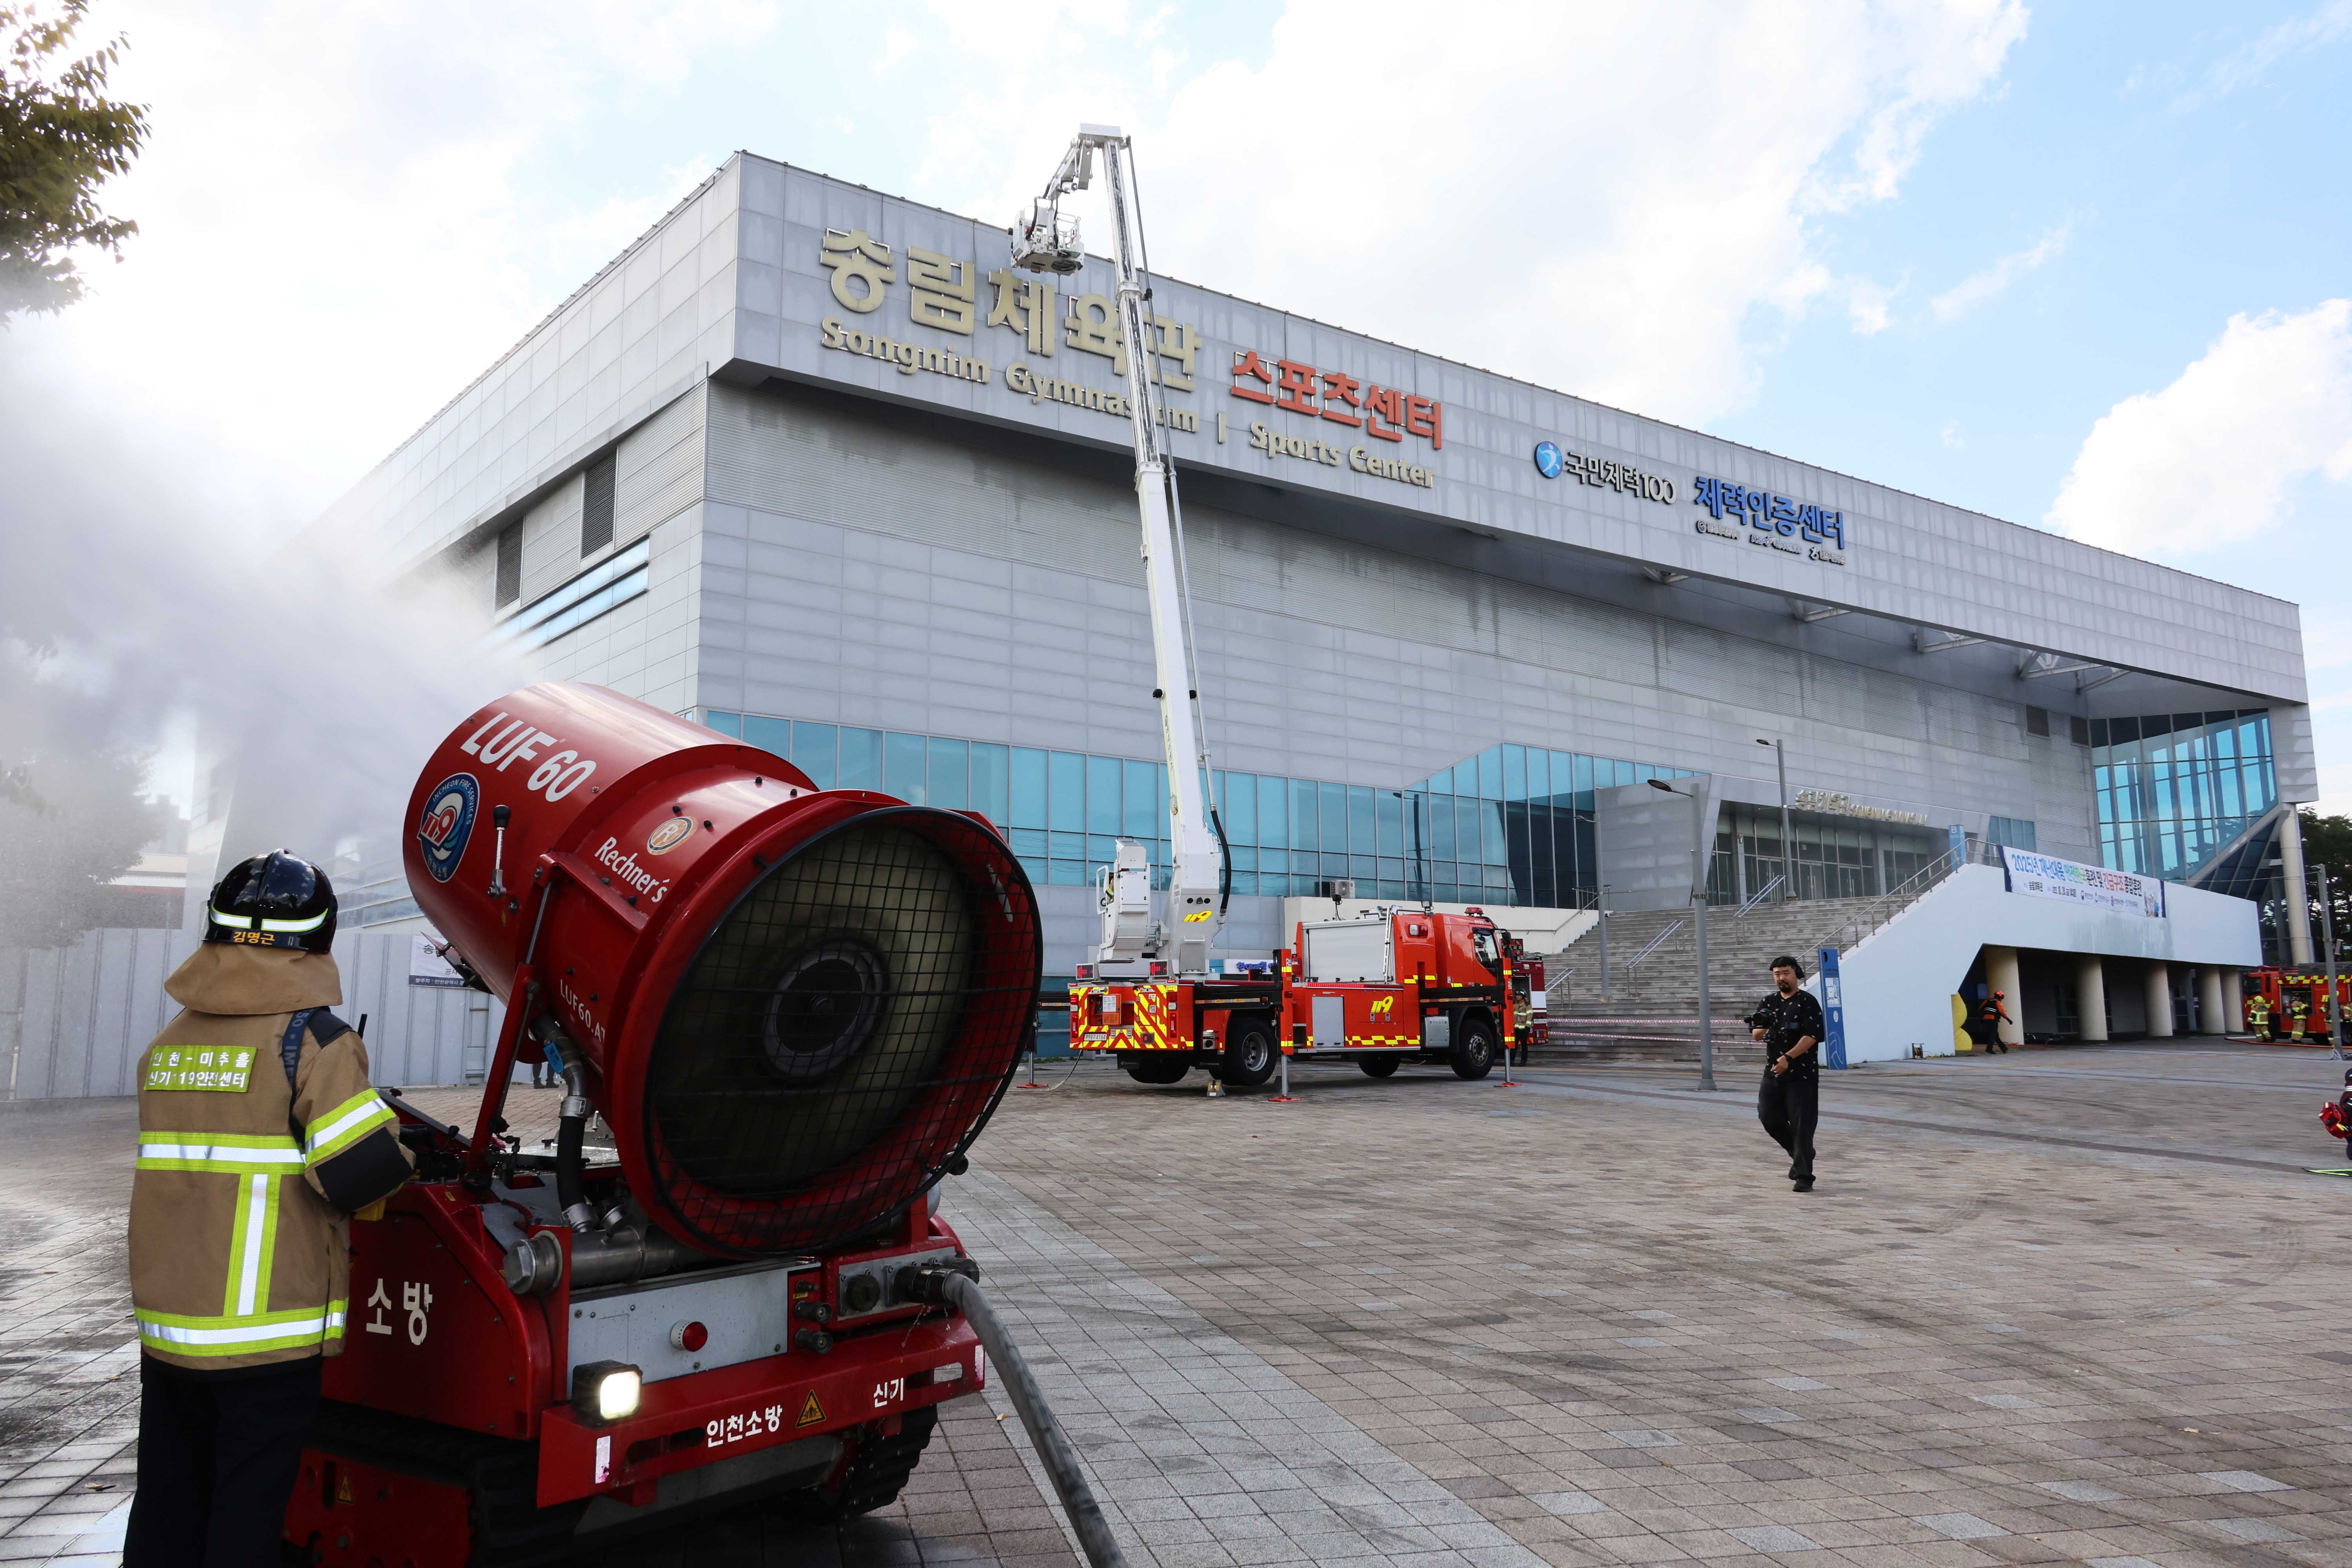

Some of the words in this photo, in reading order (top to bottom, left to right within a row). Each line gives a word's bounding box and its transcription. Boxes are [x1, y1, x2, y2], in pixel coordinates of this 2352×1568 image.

[820, 228, 1202, 392] 송림체육관
[822, 317, 990, 384] Songnim
[1005, 363, 1199, 433] Gymnaum
[1231, 351, 1441, 450] 스포츠센터
[1250, 421, 1342, 466] Sports
[1349, 445, 1435, 488] Center
[1565, 452, 1677, 505] 국민체력100
[1695, 476, 1845, 549] 체력인증센터
[1751, 534, 1770, 546] KSPO
[460, 711, 558, 772] LUF
[528, 750, 597, 802] 60
[432, 779, 459, 802] INCHEON
[459, 779, 471, 790] FIRE
[421, 808, 456, 846] 119
[2011, 853, 2042, 877] 2025년
[2096, 870, 2104, 889] 및
[2102, 872, 2124, 892] 긴급구조
[2124, 875, 2142, 897] 종합훈련
[1182, 910, 1212, 922] 119
[233, 931, 275, 945] 김명근
[1370, 996, 1394, 1013] 119
[2321, 991, 2339, 1002] 11
[366, 1278, 433, 1346] 소방
[873, 1378, 904, 1408] 신기
[707, 1405, 783, 1448] 인천소방
